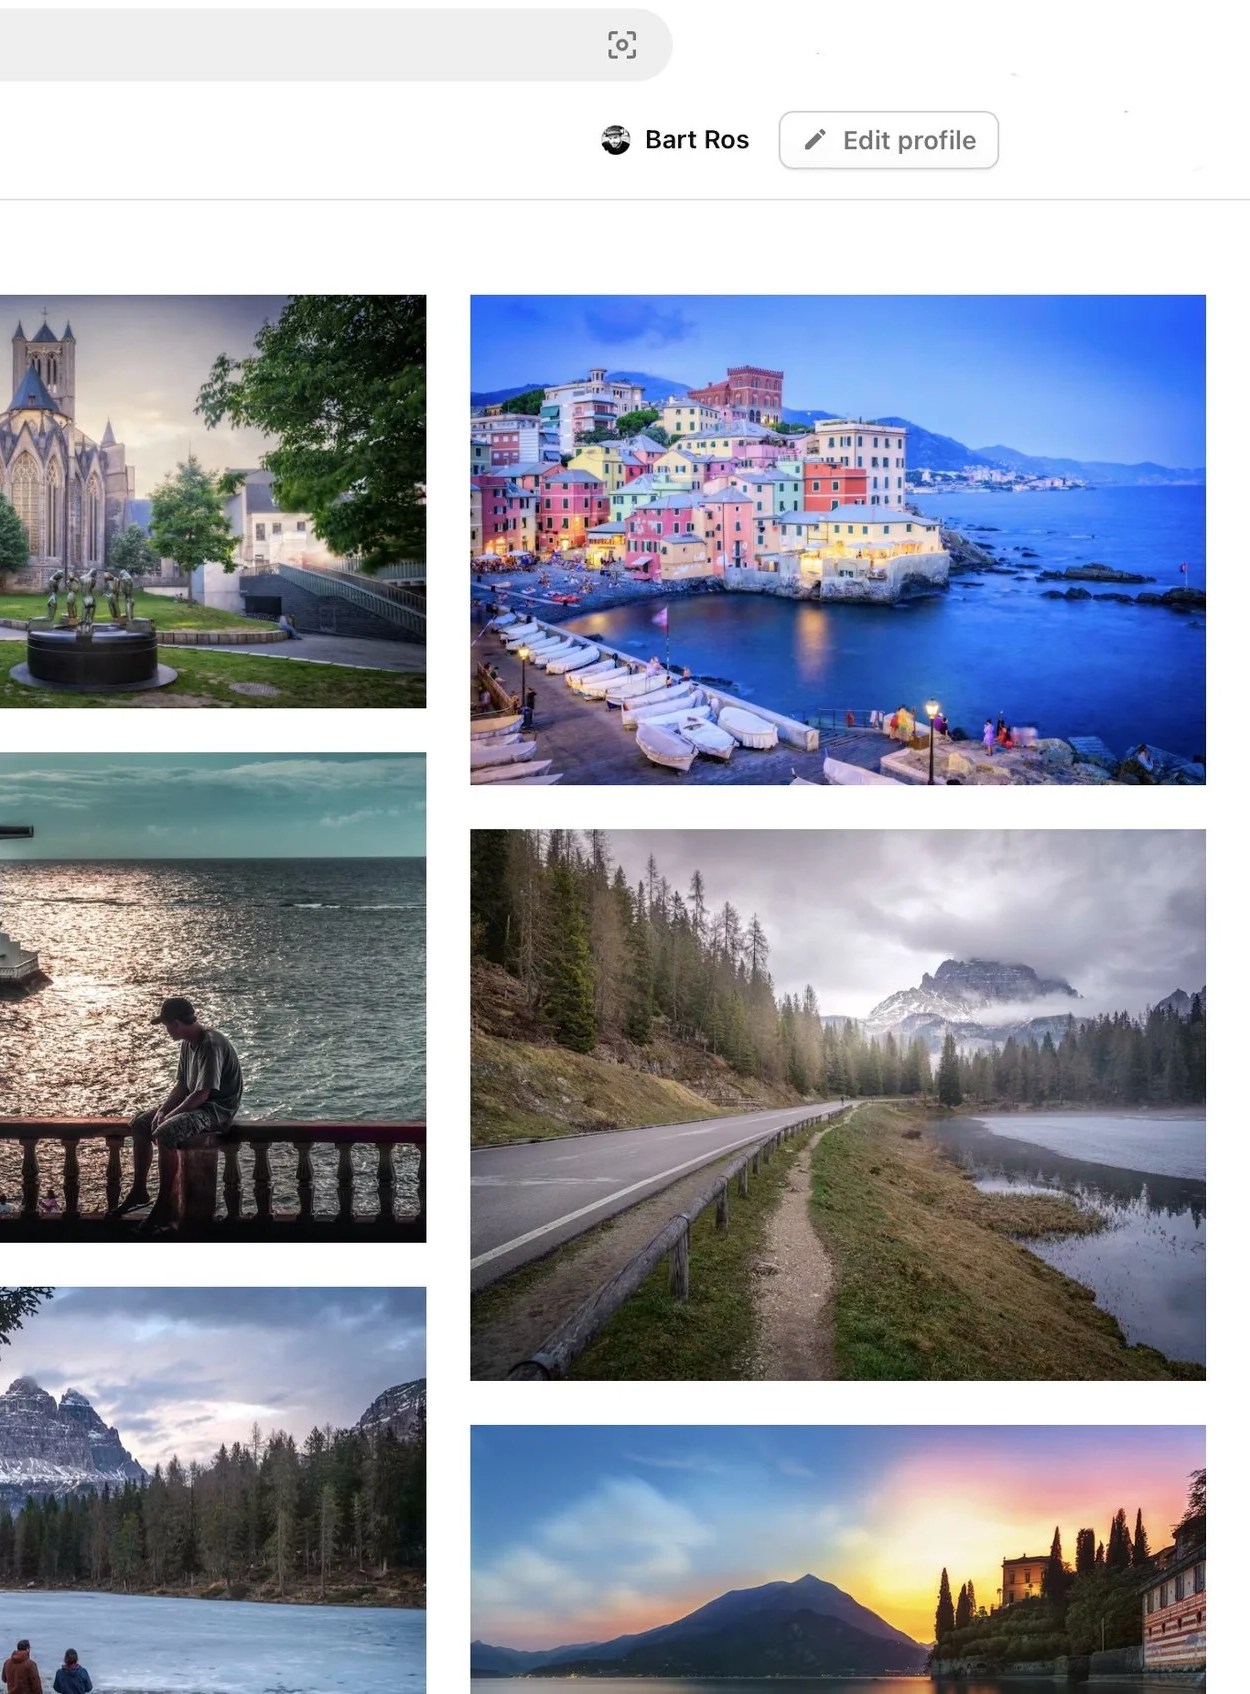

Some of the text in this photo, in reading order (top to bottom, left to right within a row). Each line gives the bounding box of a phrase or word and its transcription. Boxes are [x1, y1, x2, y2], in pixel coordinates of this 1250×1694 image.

[646, 129, 750, 150] Bart Ros
[844, 129, 977, 155] Edit profile
